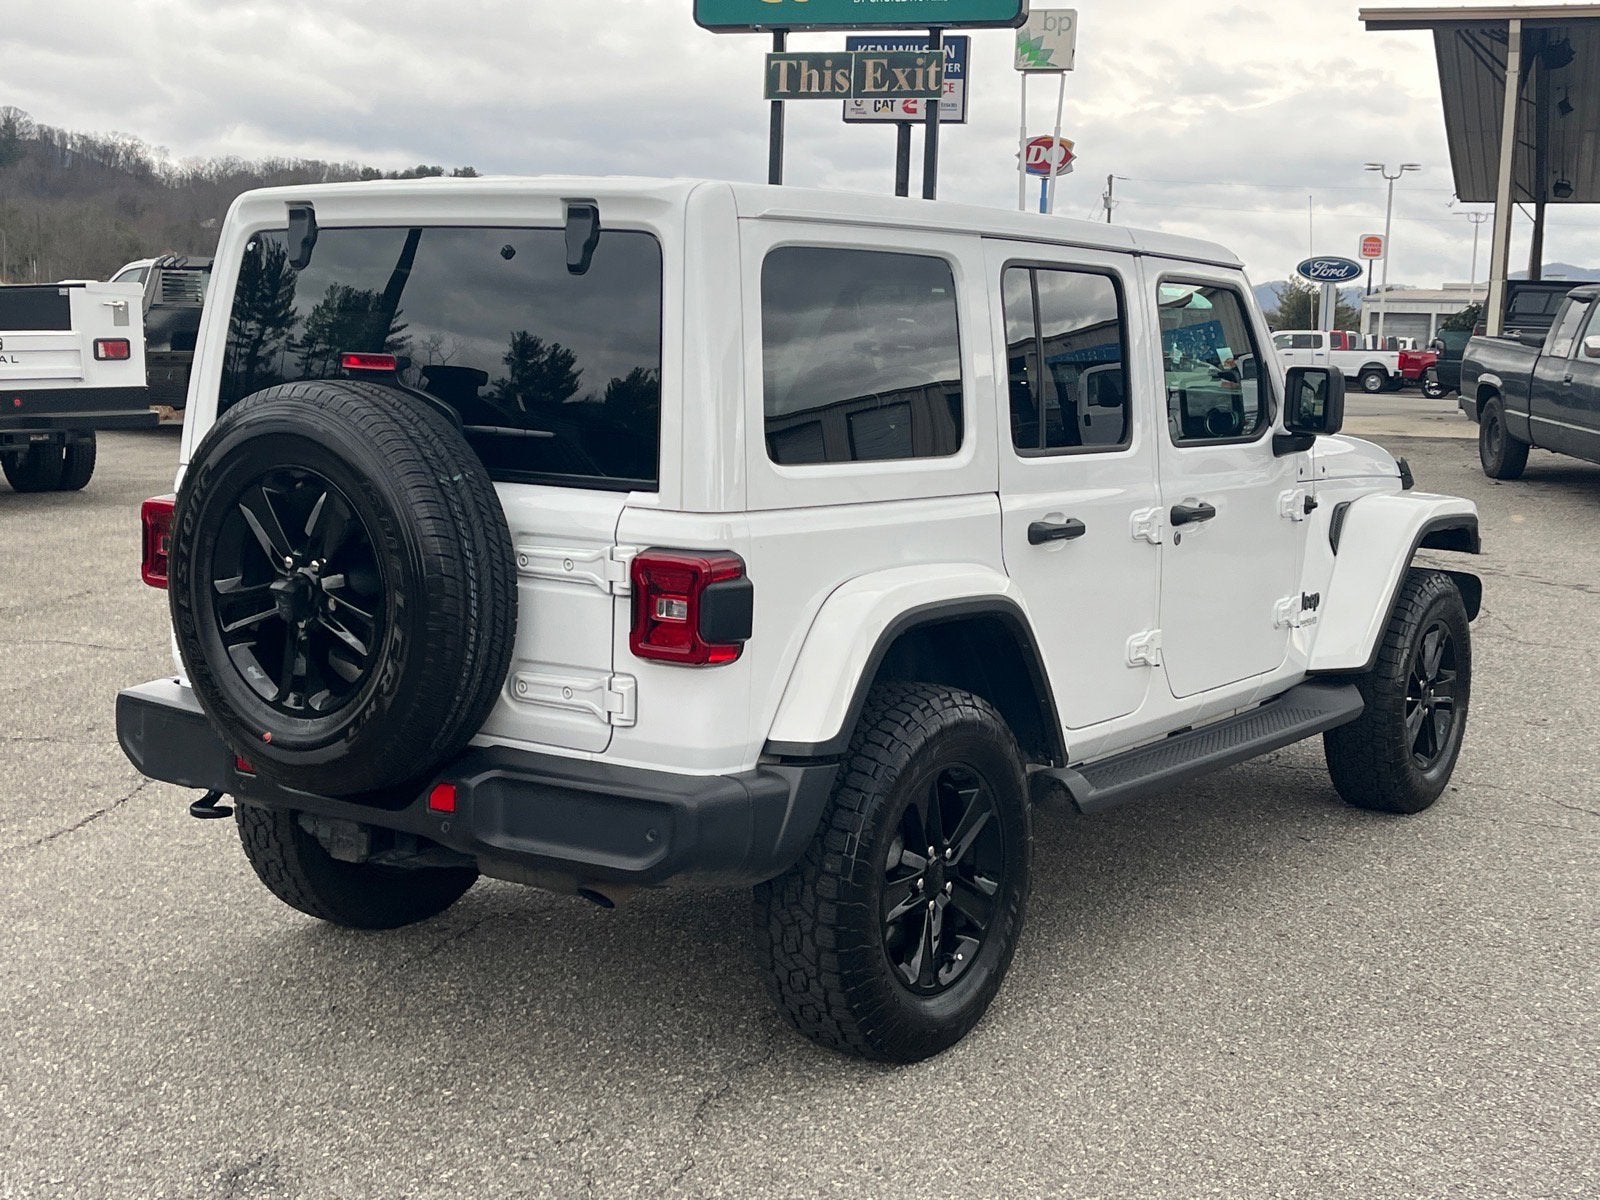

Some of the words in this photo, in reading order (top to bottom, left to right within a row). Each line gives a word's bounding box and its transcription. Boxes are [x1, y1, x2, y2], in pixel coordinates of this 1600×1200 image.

[1043, 11, 1072, 36] bp
[770, 59, 850, 93] This
[861, 57, 941, 92] Exit
[873, 99, 896, 113] CAT
[1026, 145, 1066, 167] DQ
[1310, 260, 1350, 277] Ford
[1301, 591, 1320, 611] Jeep
